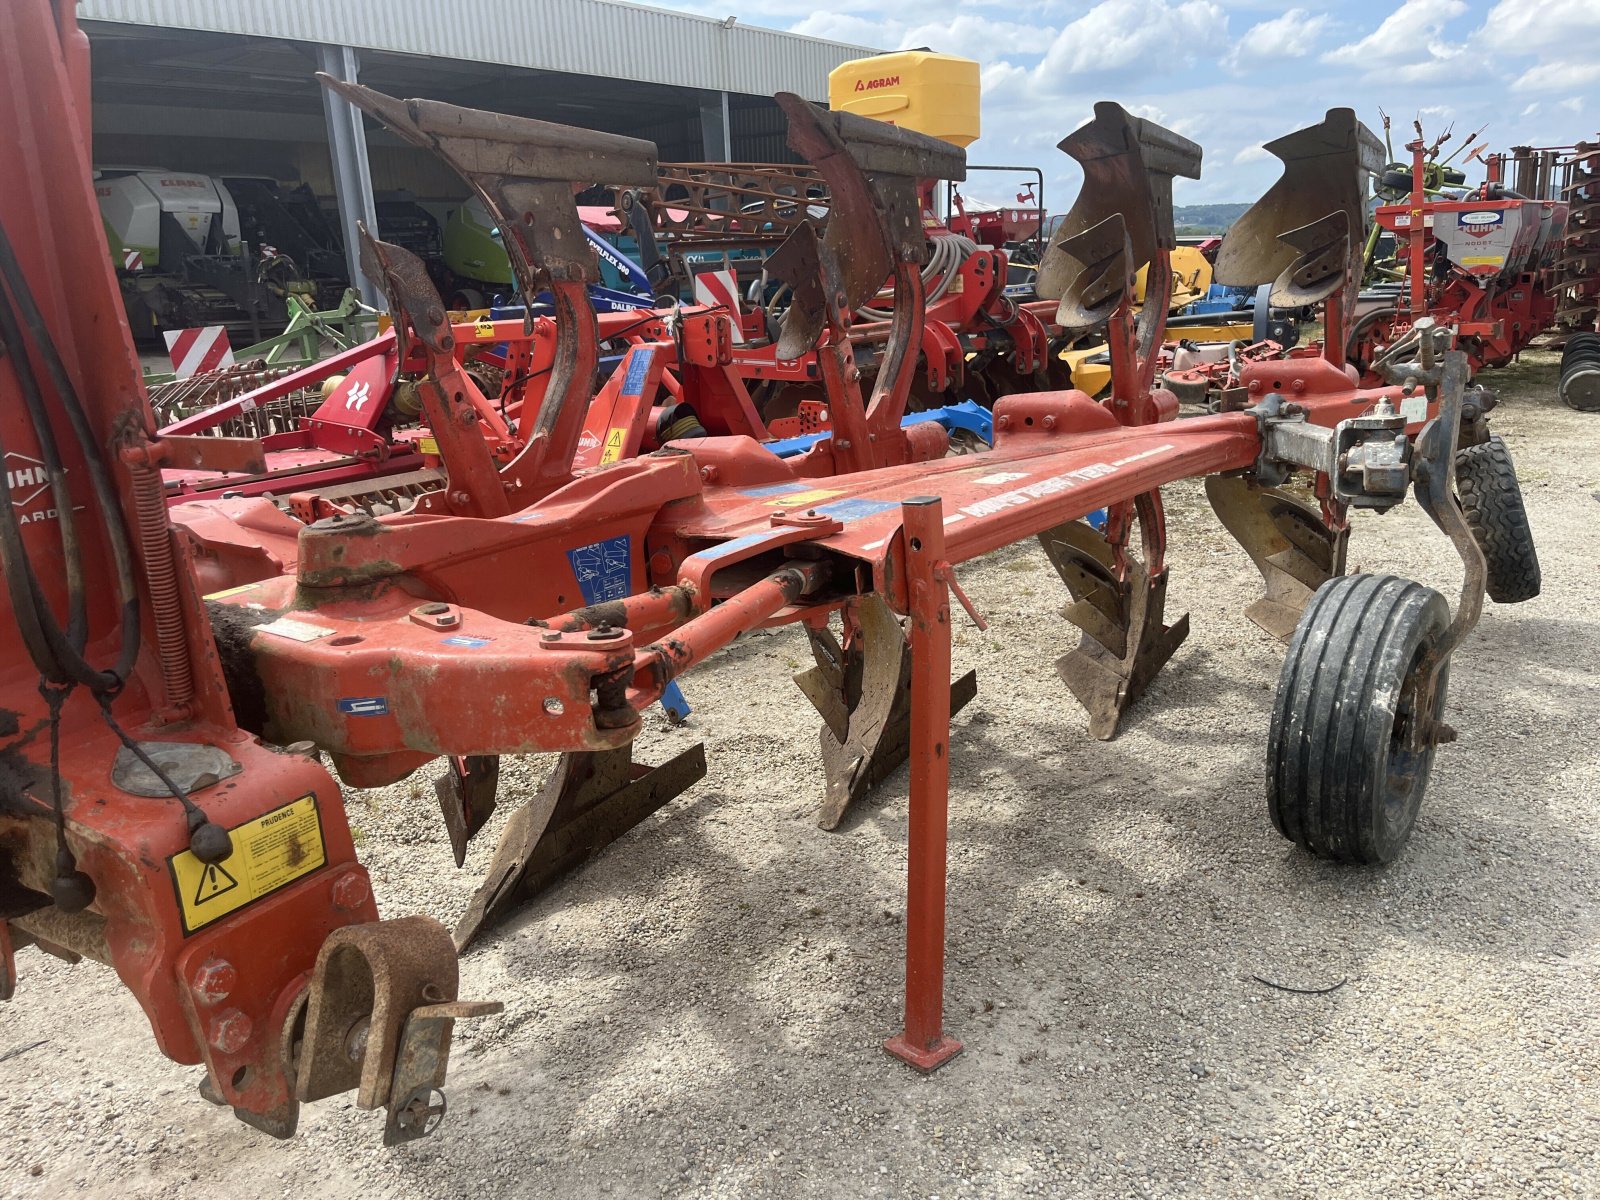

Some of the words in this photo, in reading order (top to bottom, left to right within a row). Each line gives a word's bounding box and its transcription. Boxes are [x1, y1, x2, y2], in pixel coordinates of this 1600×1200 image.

[866, 76, 900, 90] AGRAM
[160, 179, 206, 188] CLAAS
[1463, 225, 1497, 233] KUHN
[586, 237, 619, 267] EVELFLEX
[617, 262, 630, 276] 300
[578, 437, 598, 448] UHN
[260, 807, 295, 828] PRUDENCE
